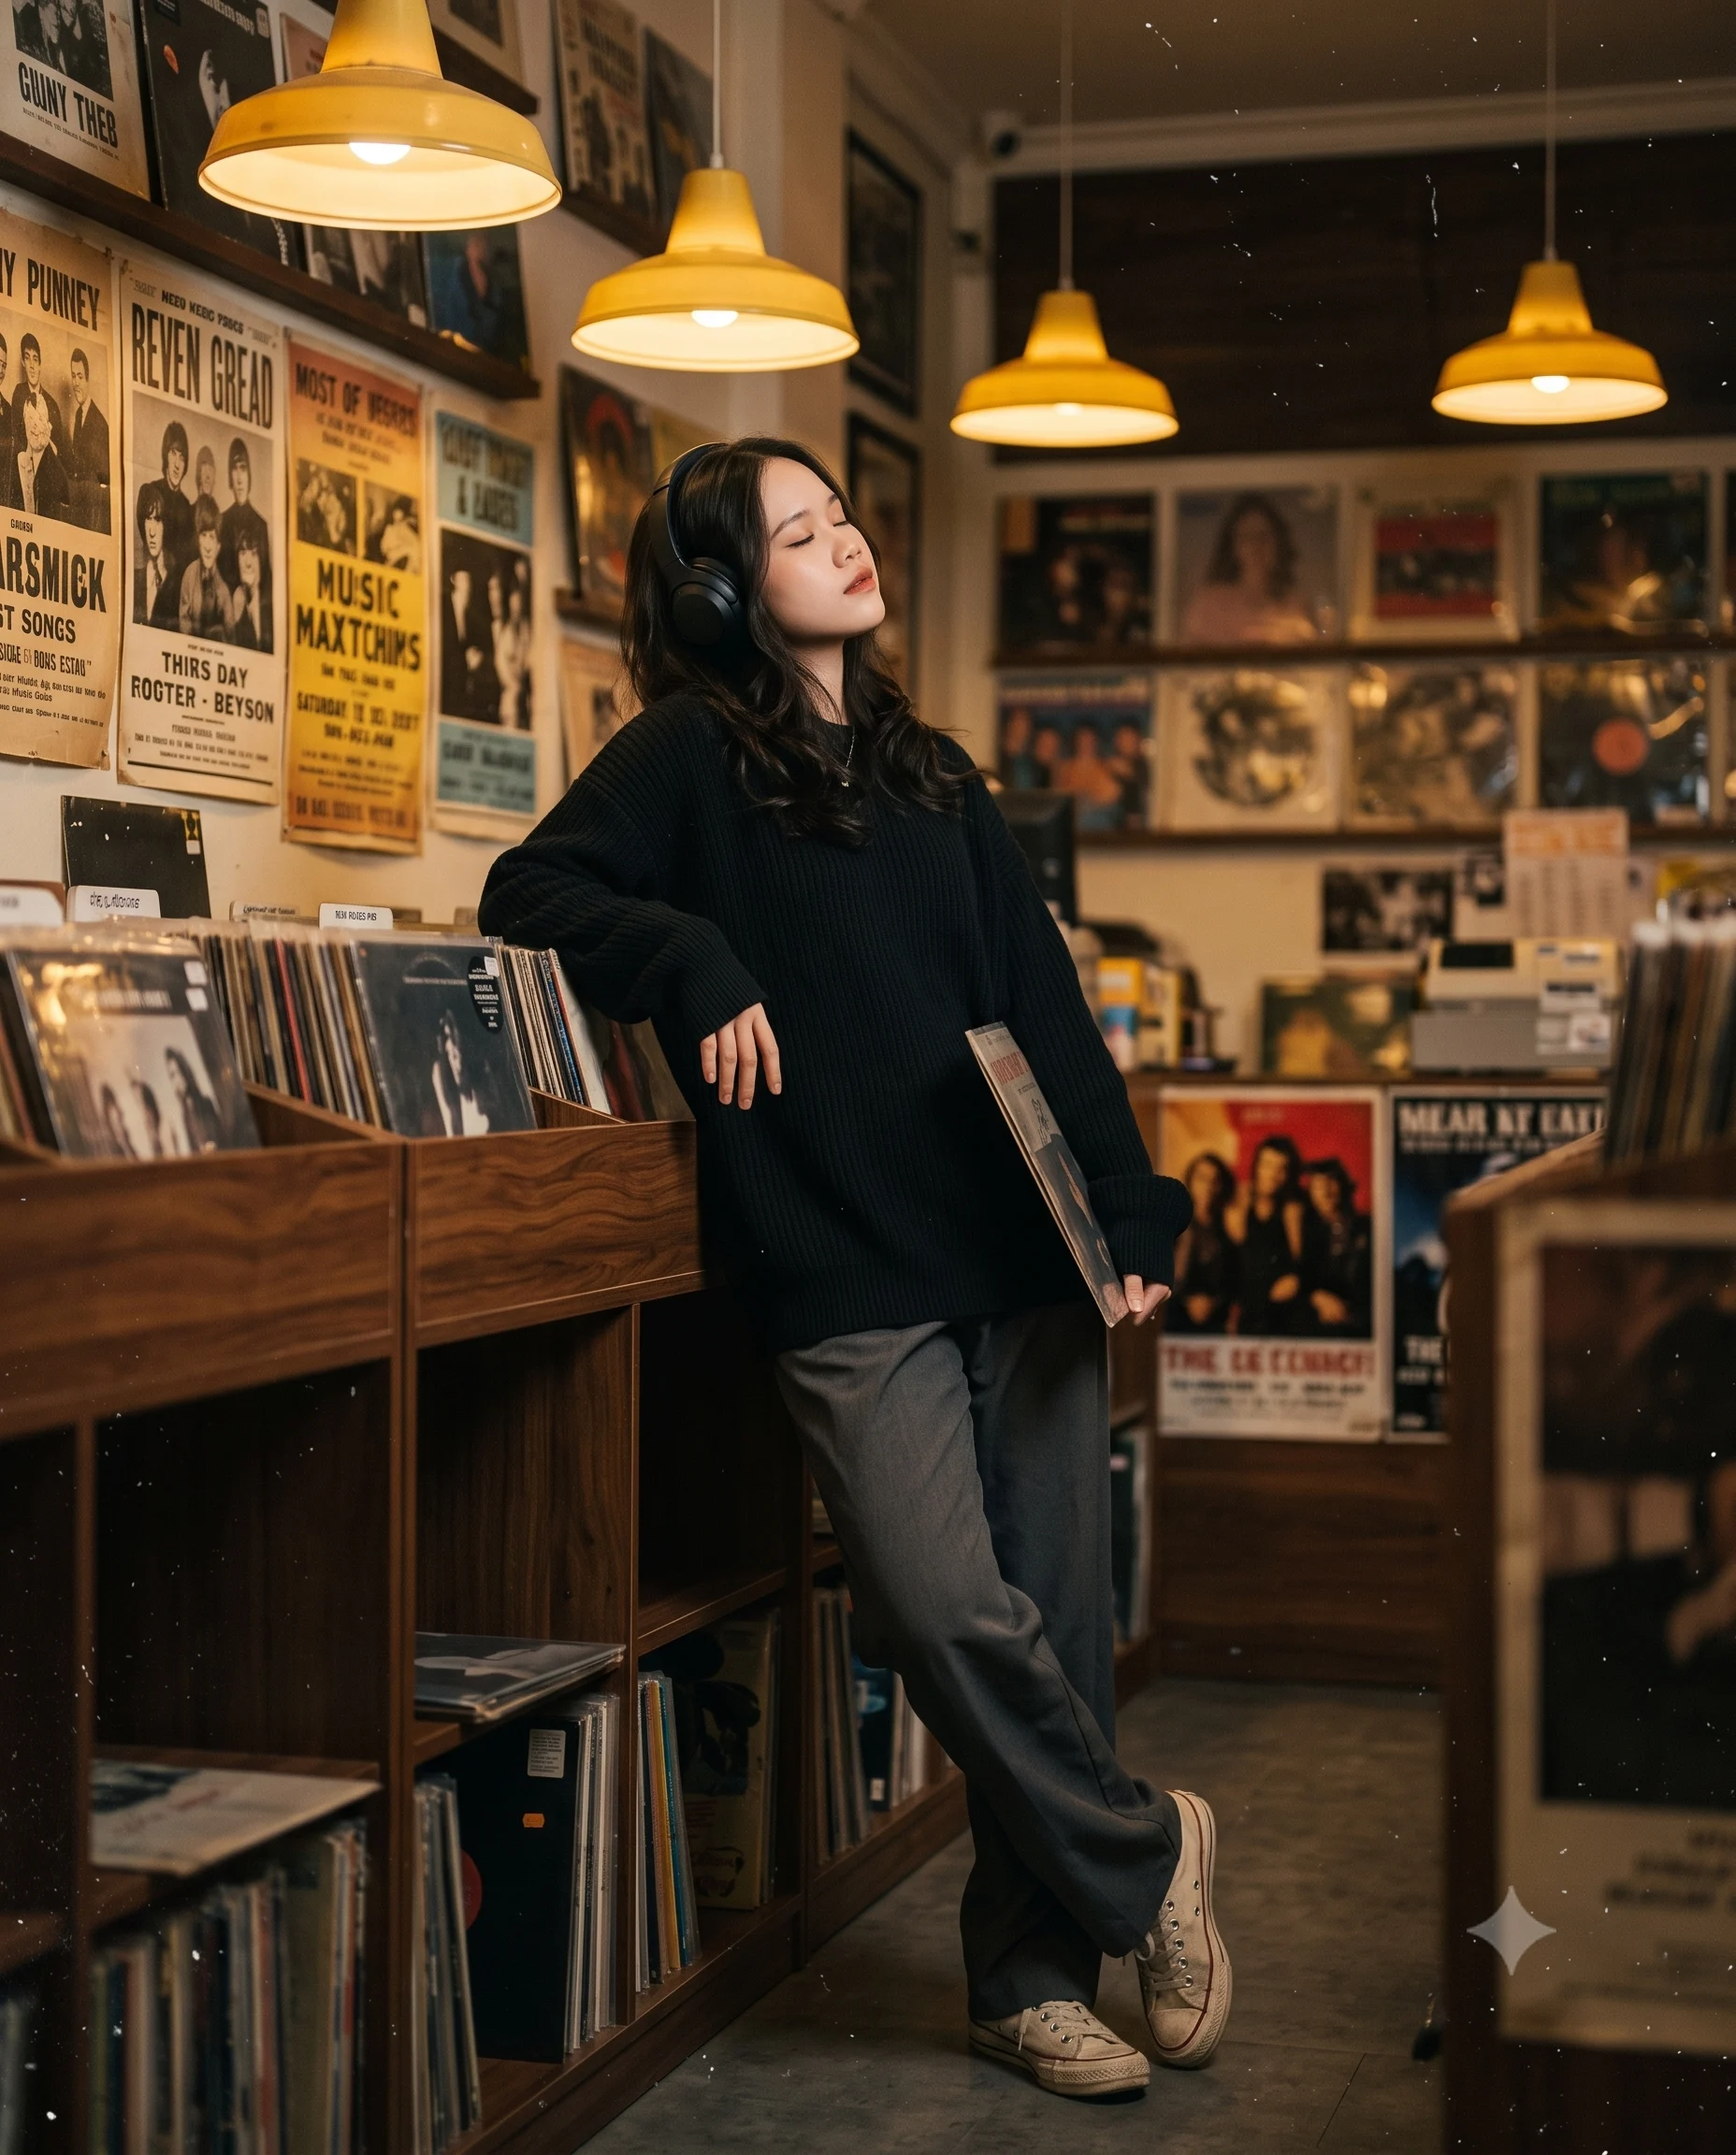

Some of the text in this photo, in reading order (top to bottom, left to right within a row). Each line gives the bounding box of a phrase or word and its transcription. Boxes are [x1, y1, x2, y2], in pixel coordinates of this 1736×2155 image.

[0, 247, 100, 332] Y PUNNEY
[132, 302, 273, 429] REVEN GREAD
[296, 362, 336, 408] MOST
[342, 382, 361, 416] OF
[317, 557, 399, 619] MUSIC
[22, 609, 77, 644] SONGS
[162, 651, 248, 688] THIRS DAY
[214, 691, 274, 724] BEYSON
